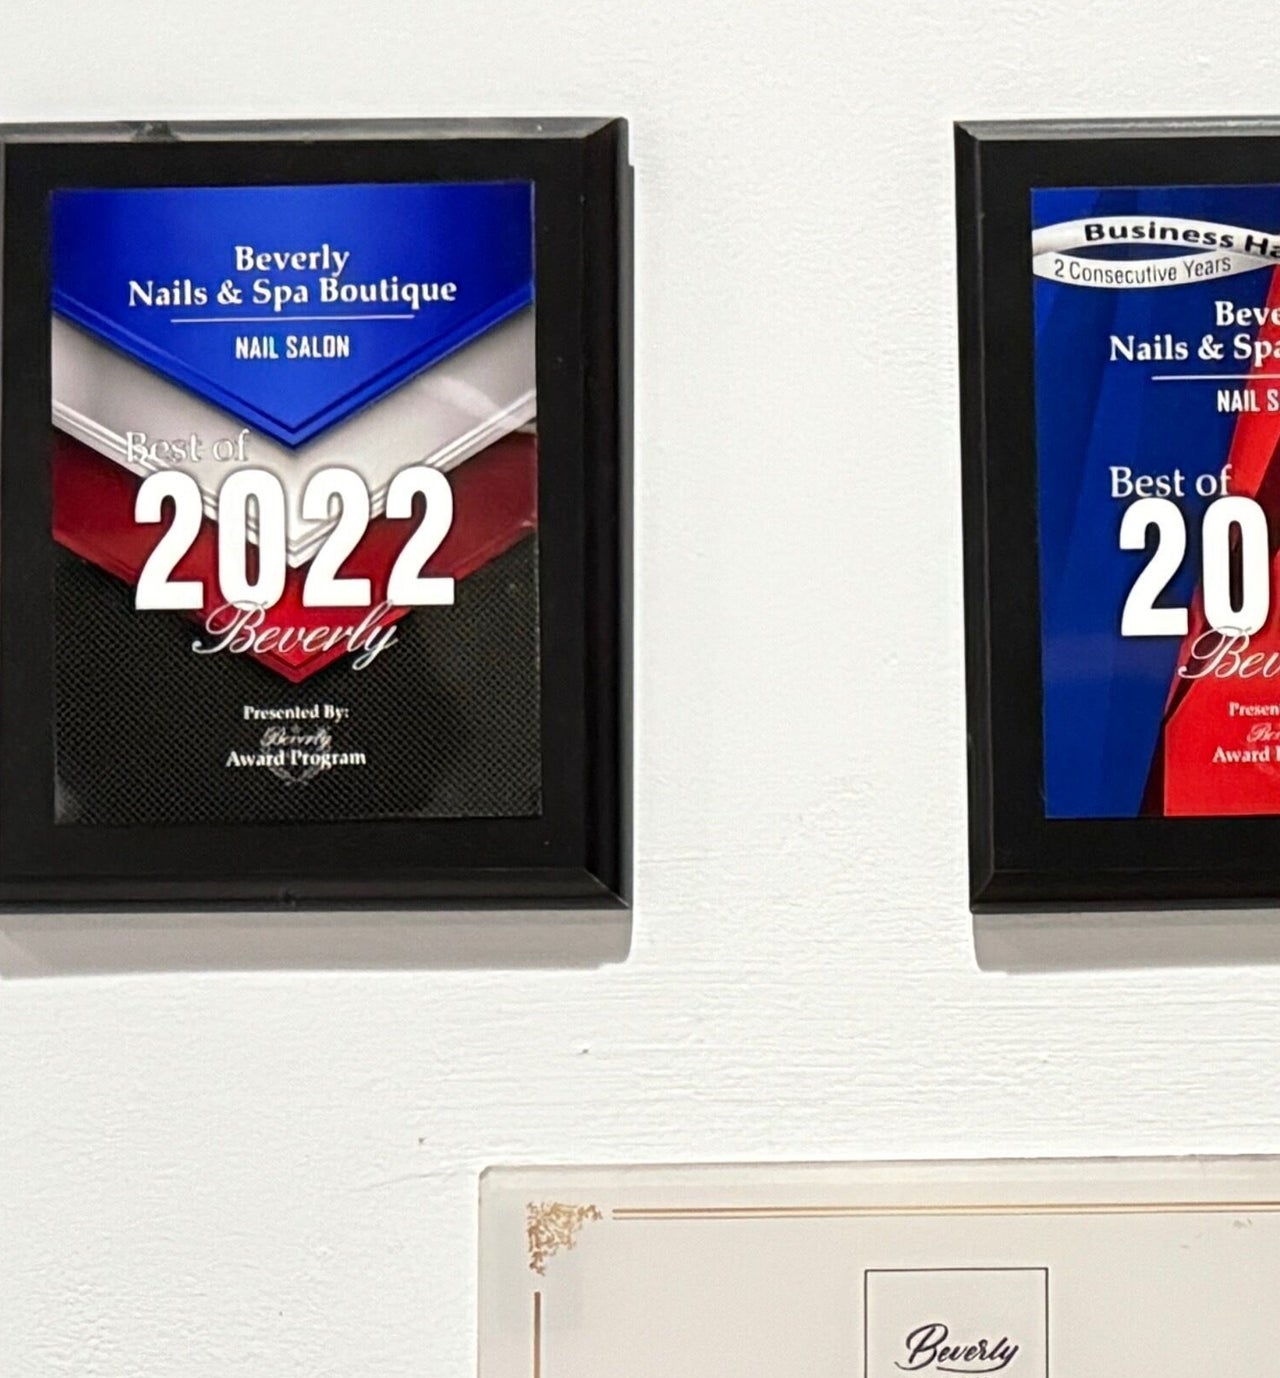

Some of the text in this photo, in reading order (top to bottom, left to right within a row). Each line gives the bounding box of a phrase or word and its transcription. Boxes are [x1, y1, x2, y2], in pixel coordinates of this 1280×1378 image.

[1085, 223, 1234, 249] Business
[235, 244, 350, 279] Beverly
[1054, 257, 1232, 284] 2 Consecutive Years
[129, 276, 457, 313] Nails & Spa Boutique
[235, 334, 350, 360] NAIL SALON
[1110, 335, 1188, 363] Nails
[1199, 336, 1224, 360] &
[1217, 389, 1260, 413] NAIL
[125, 429, 251, 465] Best of
[1110, 464, 1234, 499] Best of
[134, 467, 455, 611] 2022
[192, 598, 400, 671] Beverly
[243, 704, 349, 723] Presented By:
[225, 750, 367, 771] Award Program
[1212, 746, 1270, 763] Award
[894, 1323, 1020, 1374] Beverly
